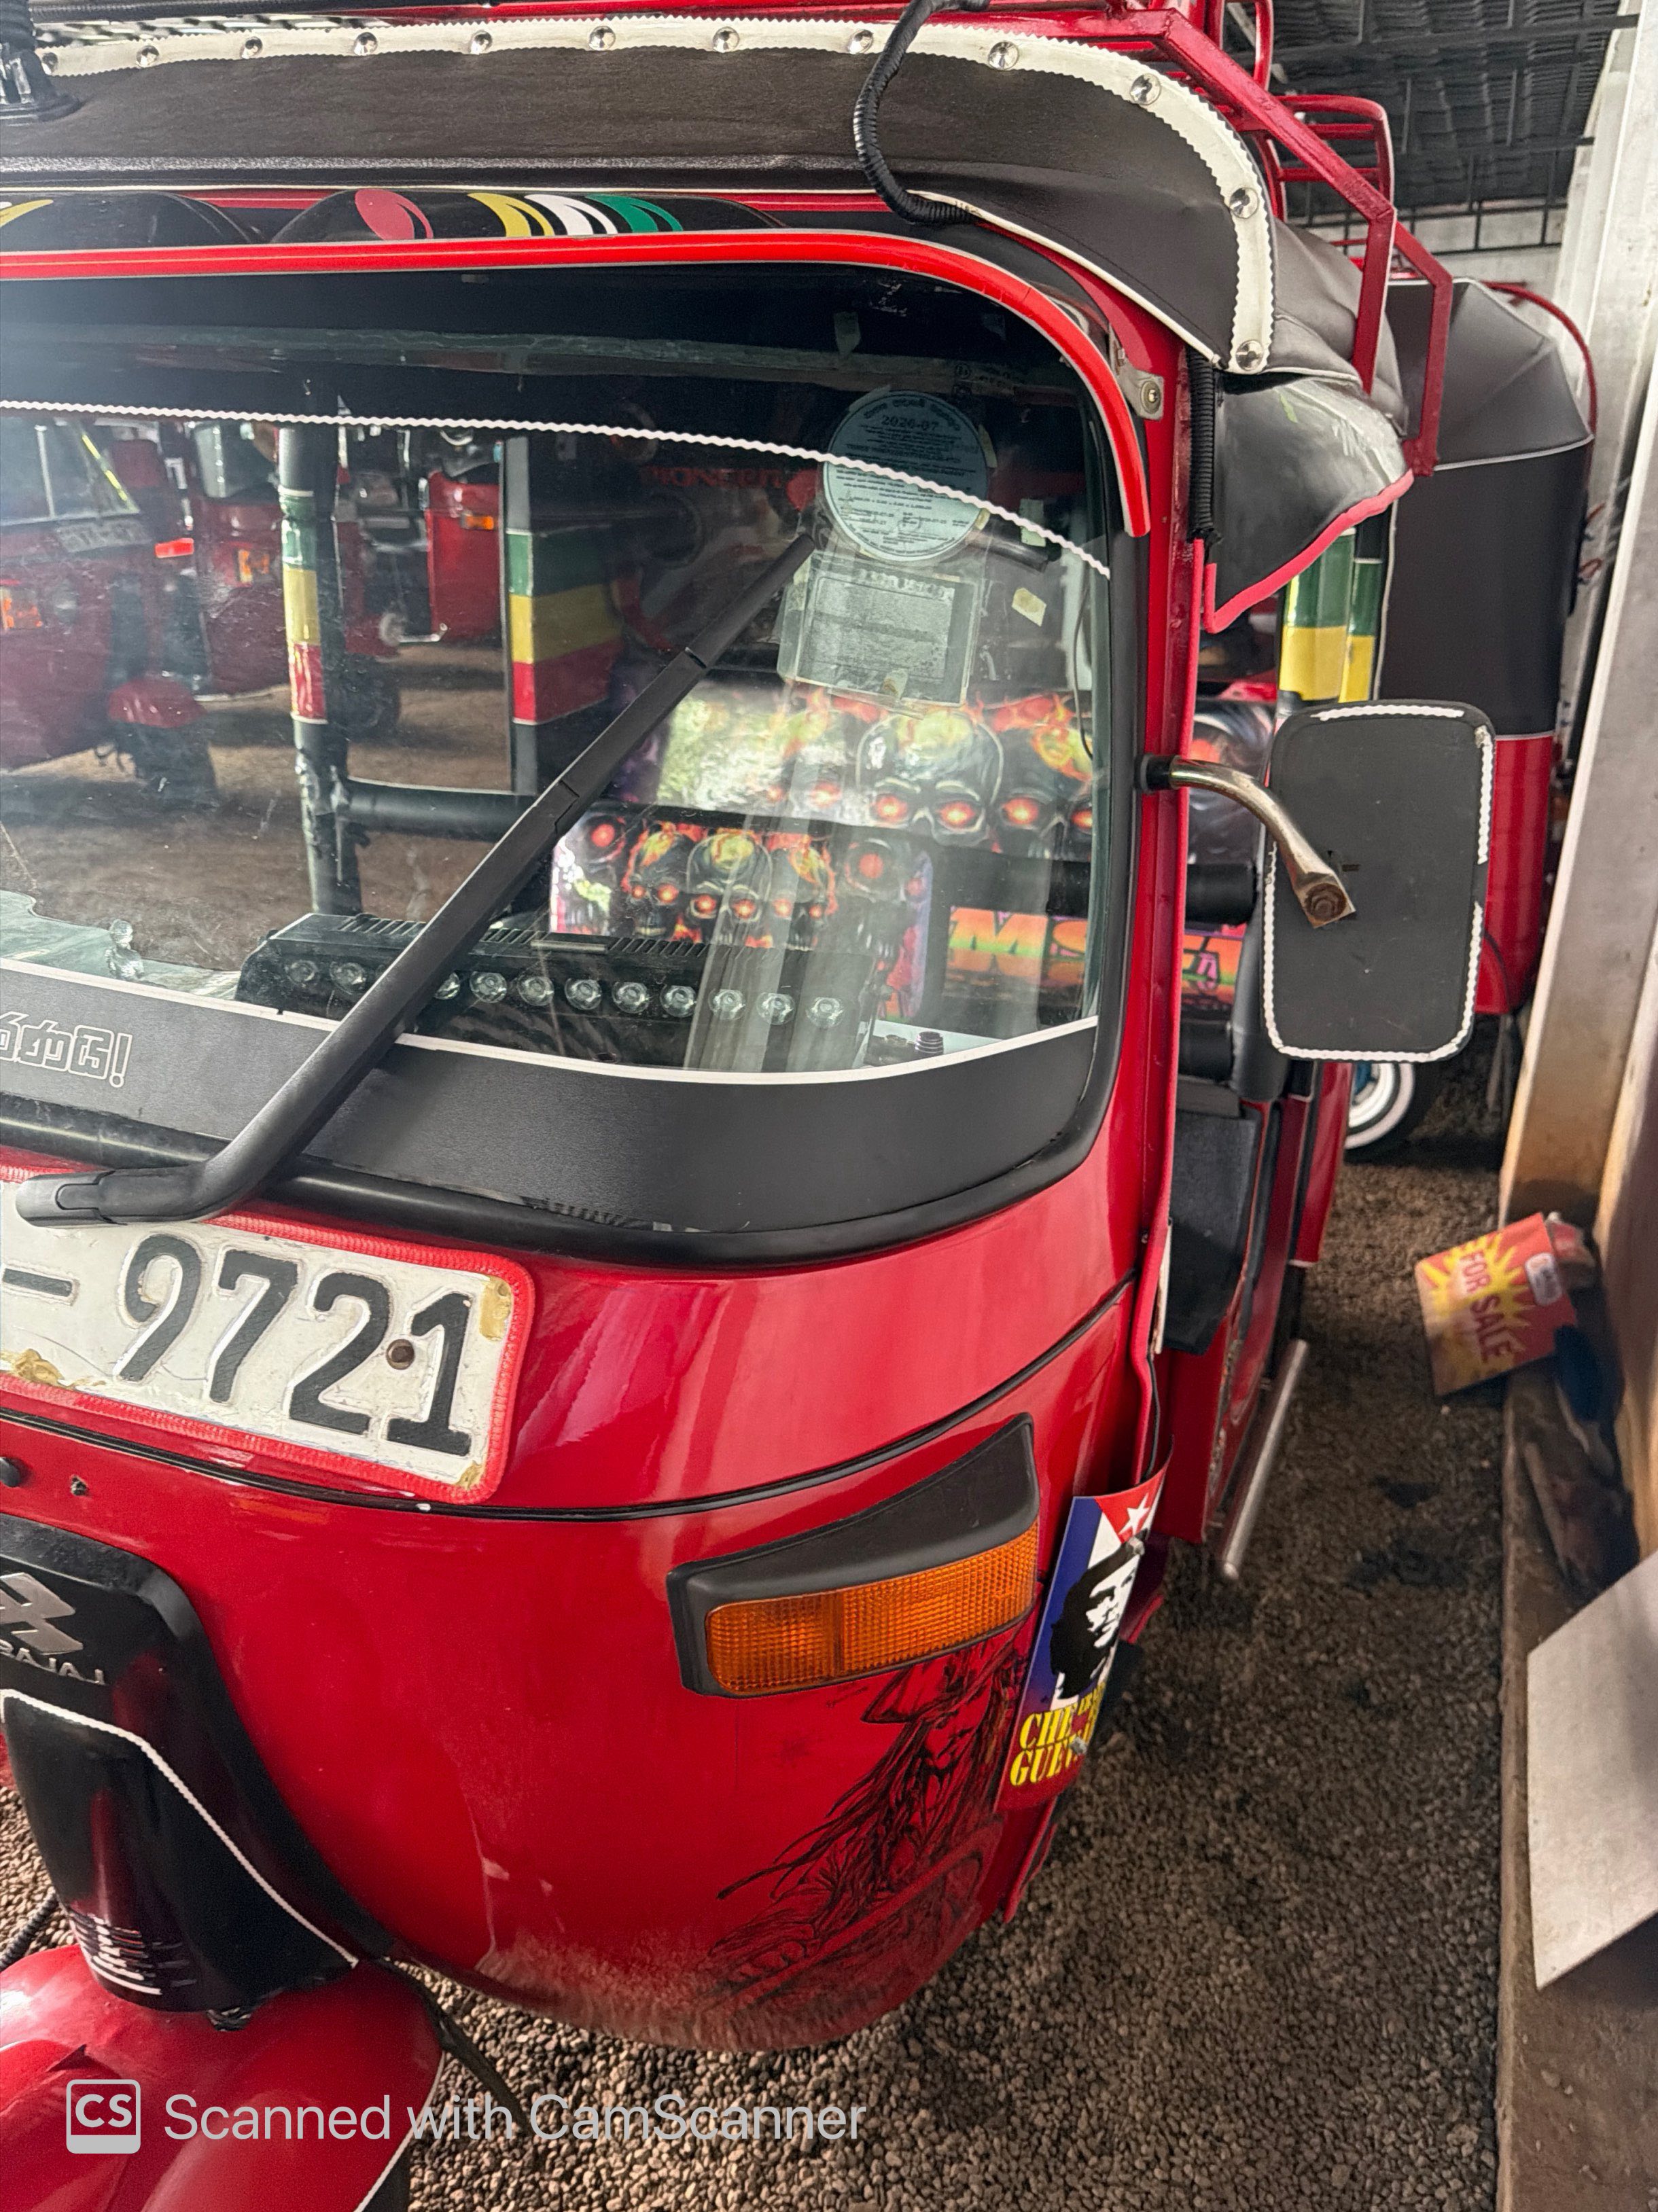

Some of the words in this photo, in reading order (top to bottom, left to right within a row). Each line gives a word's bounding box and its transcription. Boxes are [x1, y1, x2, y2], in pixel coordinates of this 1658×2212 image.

[1461, 1250, 1492, 1294] FOR
[113, 1232, 474, 1458] 9721
[1470, 1294, 1513, 1363] SALE
[1019, 1700, 1078, 1749] CHE
